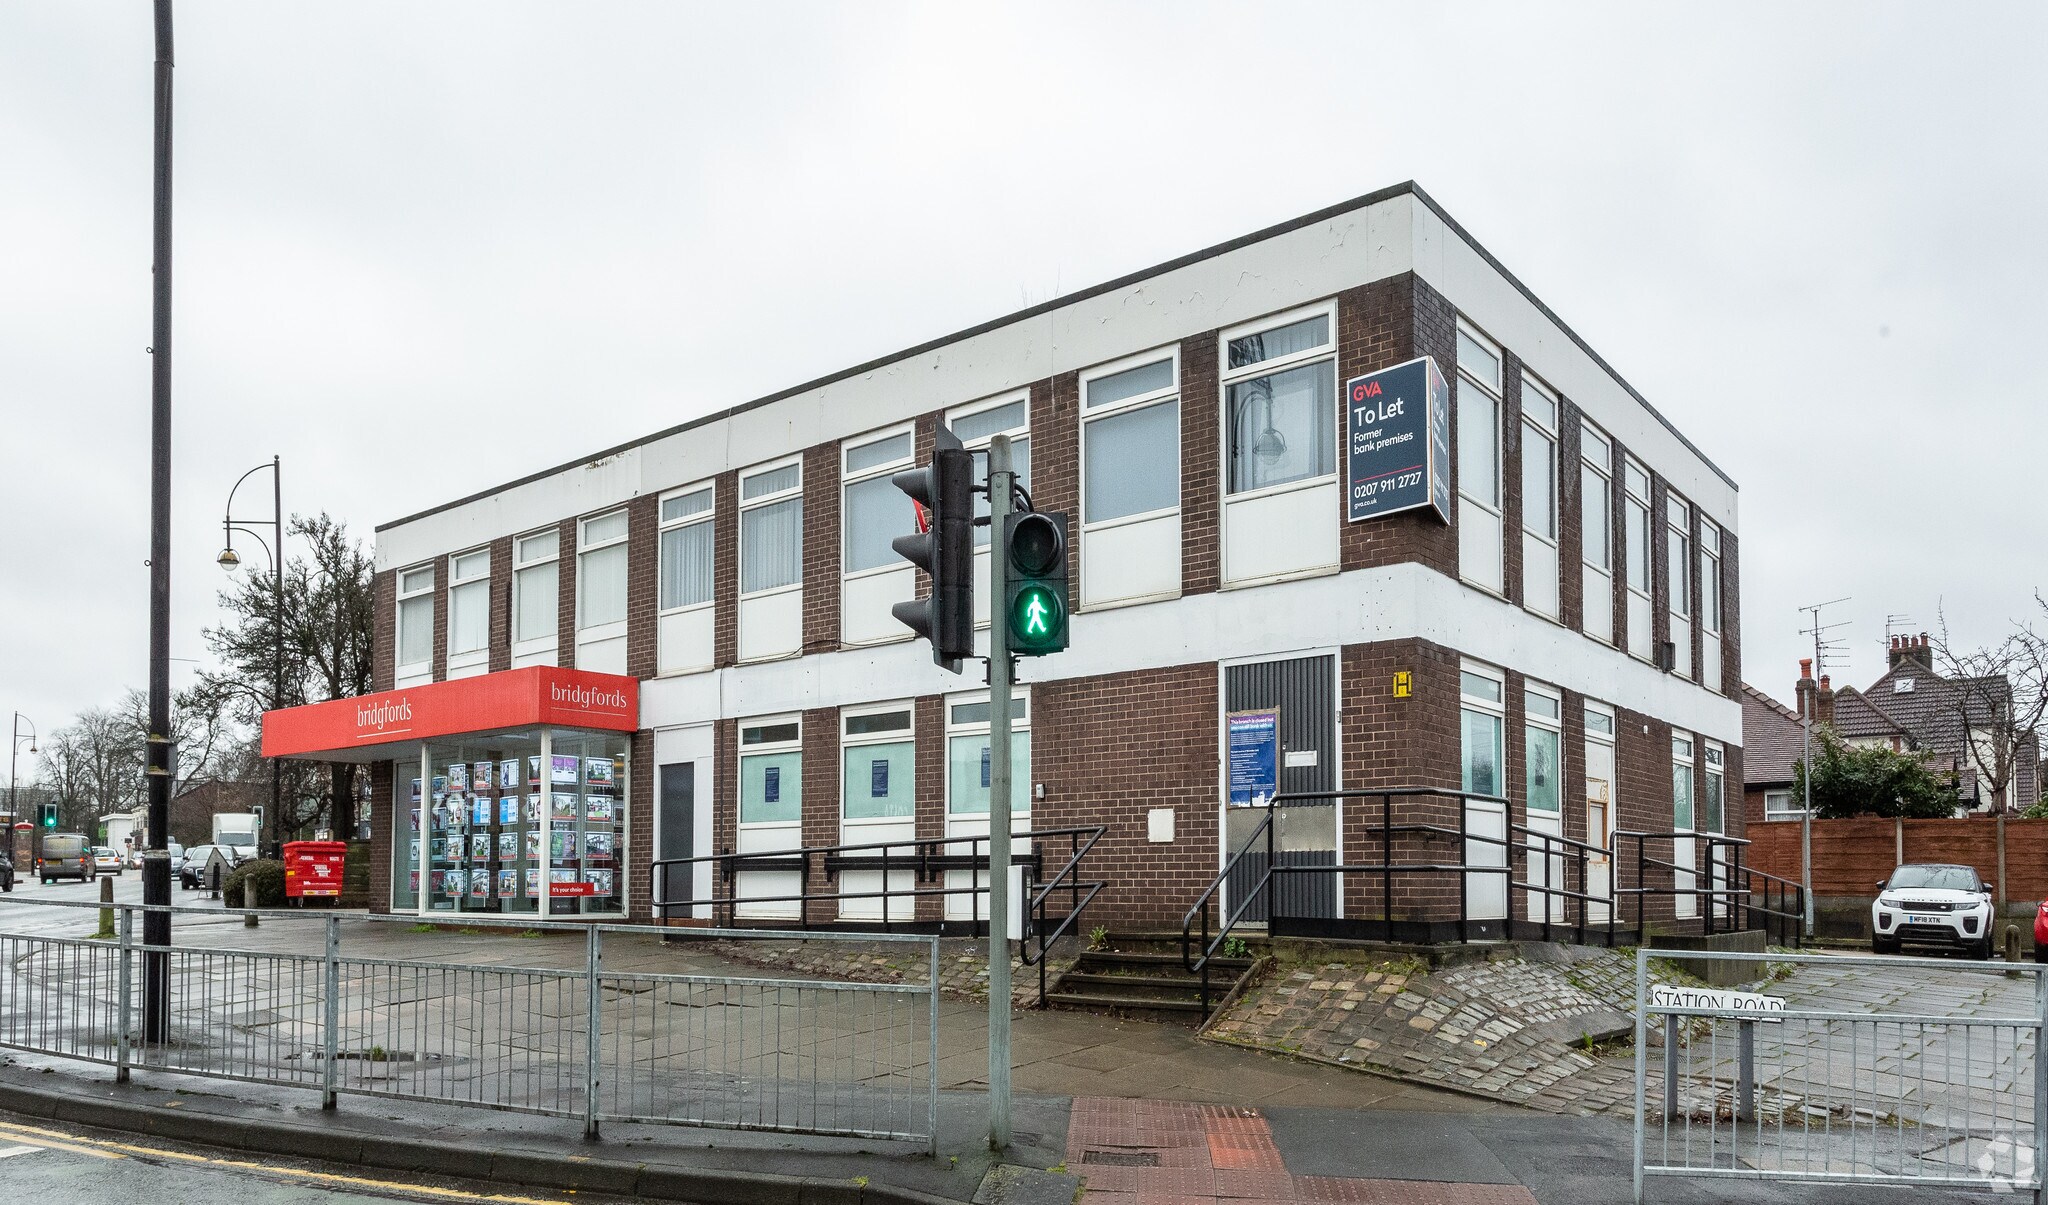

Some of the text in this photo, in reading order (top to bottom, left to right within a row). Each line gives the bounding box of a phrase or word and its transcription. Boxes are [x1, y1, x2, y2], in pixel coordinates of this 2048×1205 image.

[1353, 381, 1382, 401] GVA
[1354, 397, 1404, 427] To Let
[1354, 428, 1382, 443] Former
[1354, 432, 1414, 455] bank premises
[1354, 482, 1379, 499] 0207
[1381, 478, 1395, 493] 911
[1398, 471, 1422, 489] 2727
[1354, 498, 1378, 510] gva.co.uk
[551, 682, 627, 708] bridgfords
[1396, 674, 1409, 695] H
[357, 697, 412, 729] bridgfords
[1654, 990, 1724, 1009] STATION
